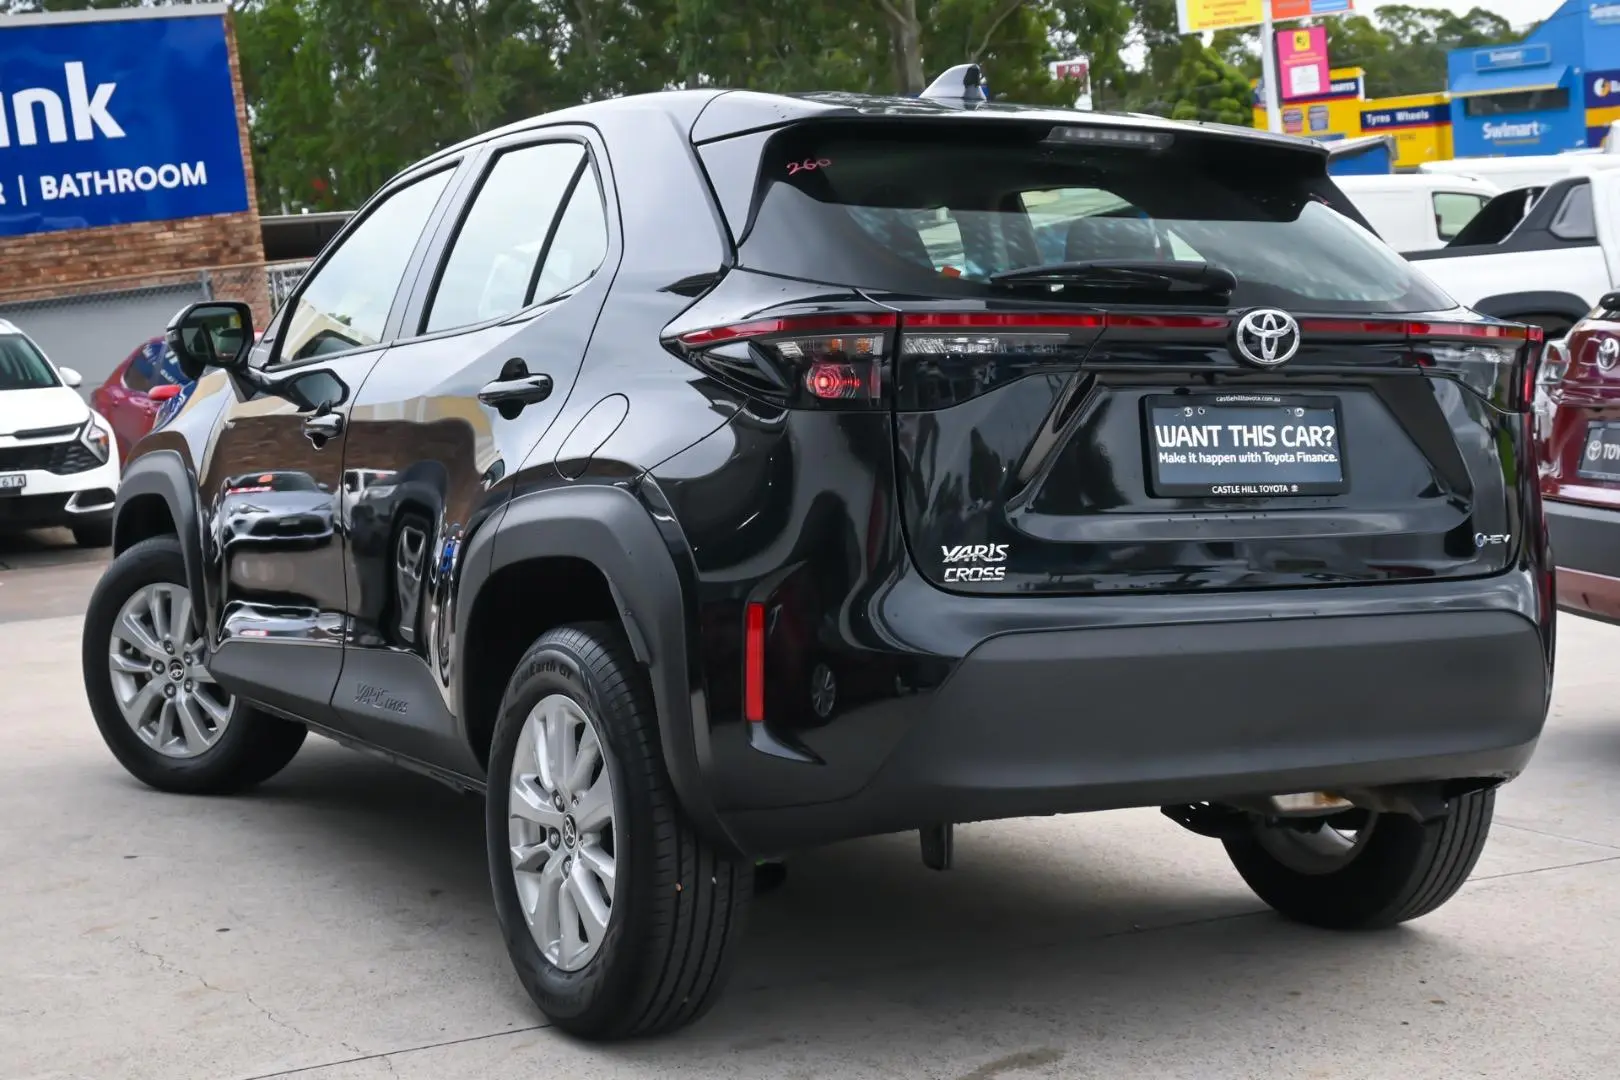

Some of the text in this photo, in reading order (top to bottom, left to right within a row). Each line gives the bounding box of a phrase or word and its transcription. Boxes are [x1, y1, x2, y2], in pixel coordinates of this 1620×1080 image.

[1395, 110, 1429, 122] Wheels
[40, 161, 208, 201] BATHROOM
[1155, 425, 1335, 447] WANT THIS CAR?
[1159, 452, 1338, 466] Make it happen with Toyota Finance.
[1211, 484, 1288, 494] CASTLE HILL TOYOTA
[941, 543, 1010, 563] YARIS
[944, 566, 1006, 582] CROSS
